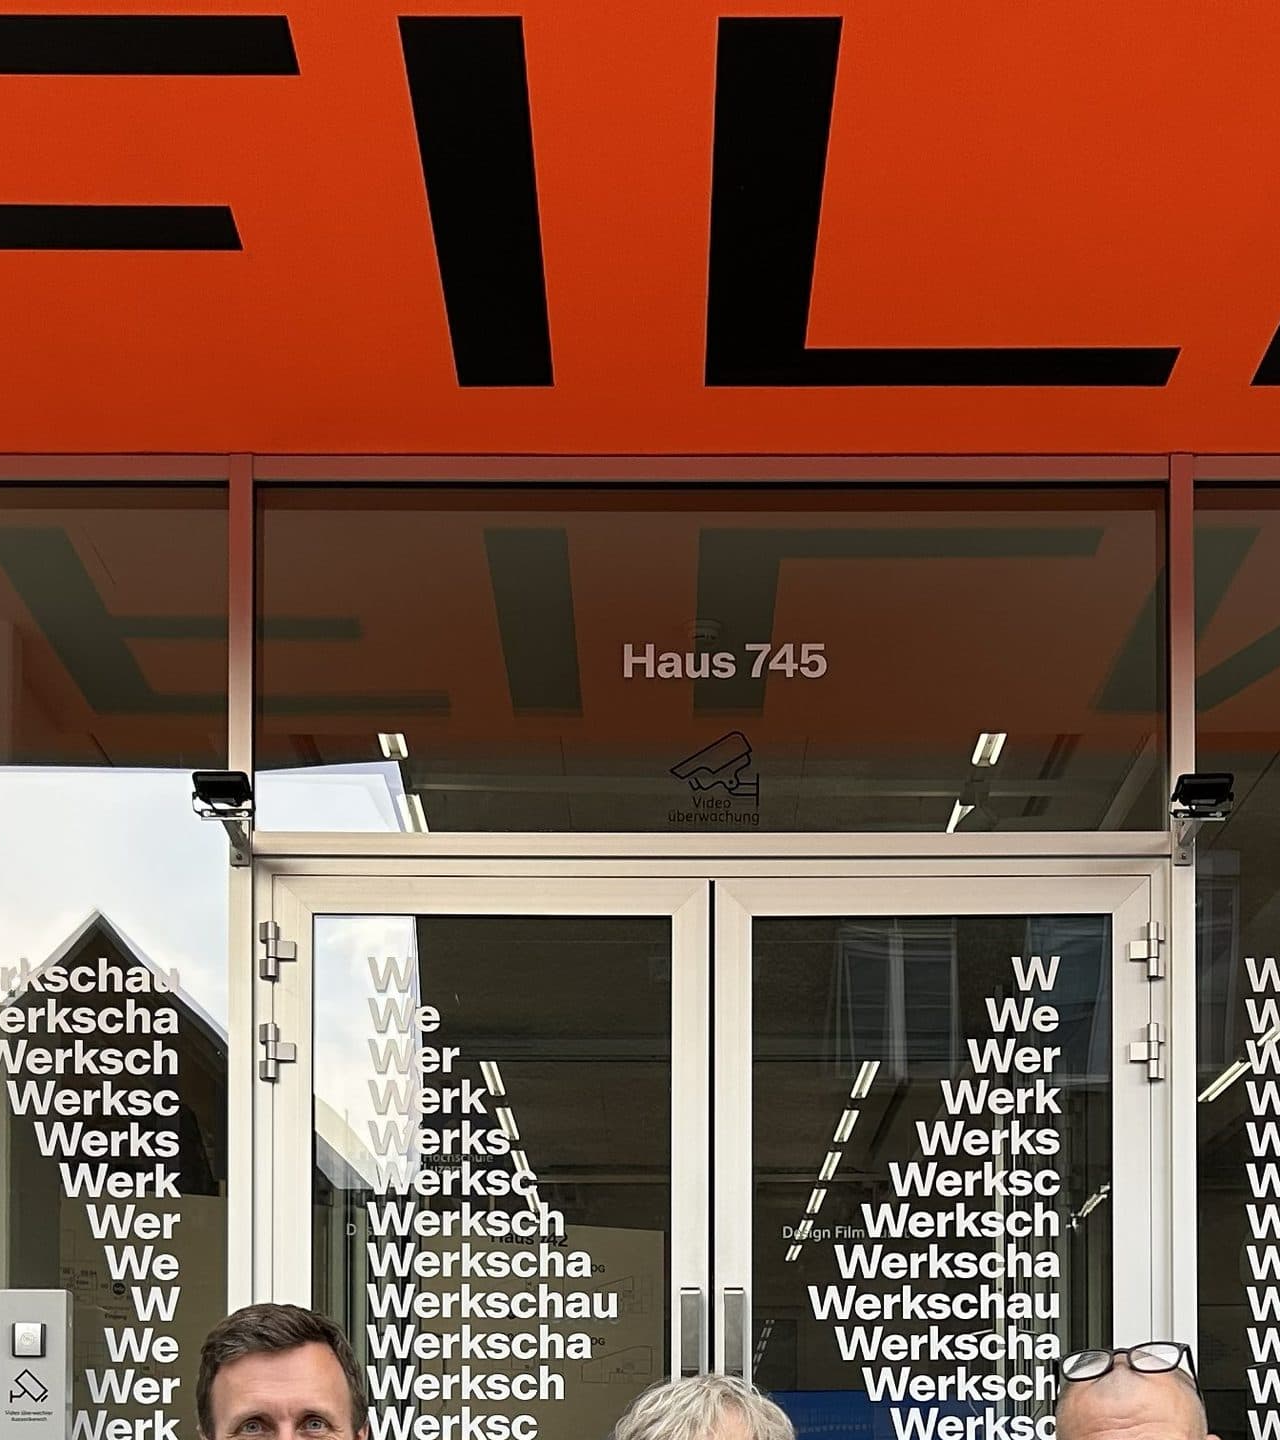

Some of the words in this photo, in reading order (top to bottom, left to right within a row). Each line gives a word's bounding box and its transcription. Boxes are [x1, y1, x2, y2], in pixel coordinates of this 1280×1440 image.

[623, 643, 737, 679] Haus
[745, 643, 828, 679] 745
[368, 957, 414, 993] W
[1012, 957, 1061, 991] W
[368, 998, 440, 1032] We
[986, 998, 1060, 1032] We
[368, 1039, 460, 1073] Wer
[967, 1039, 1061, 1073] Wer
[7, 1081, 179, 1116] Werksc
[368, 1080, 487, 1115] Werk
[942, 1080, 1062, 1114] Werk
[34, 1122, 178, 1157] Werks
[368, 1121, 511, 1156] Werks
[916, 1121, 1060, 1156] Werks
[59, 1164, 181, 1198] Werk
[370, 1161, 538, 1196] Werksc
[889, 1162, 1060, 1197] Werksc
[86, 1205, 180, 1239] Wer
[367, 1202, 564, 1237] Werksch
[835, 1226, 865, 1239] Film
[861, 1203, 1060, 1238] Werksch
[105, 1246, 179, 1281] We
[367, 1243, 592, 1278] Werkscha
[835, 1244, 1061, 1279] Werkscha
[131, 1287, 181, 1321] W
[367, 1284, 618, 1319] Werkschau
[808, 1285, 1061, 1320] Werkschau
[105, 1328, 179, 1363] We
[367, 1325, 592, 1360] Werkscha
[836, 1326, 1061, 1361] Werkscha
[85, 1369, 180, 1404] Wer
[367, 1366, 565, 1400] Werksch
[862, 1367, 1060, 1401] Werksch
